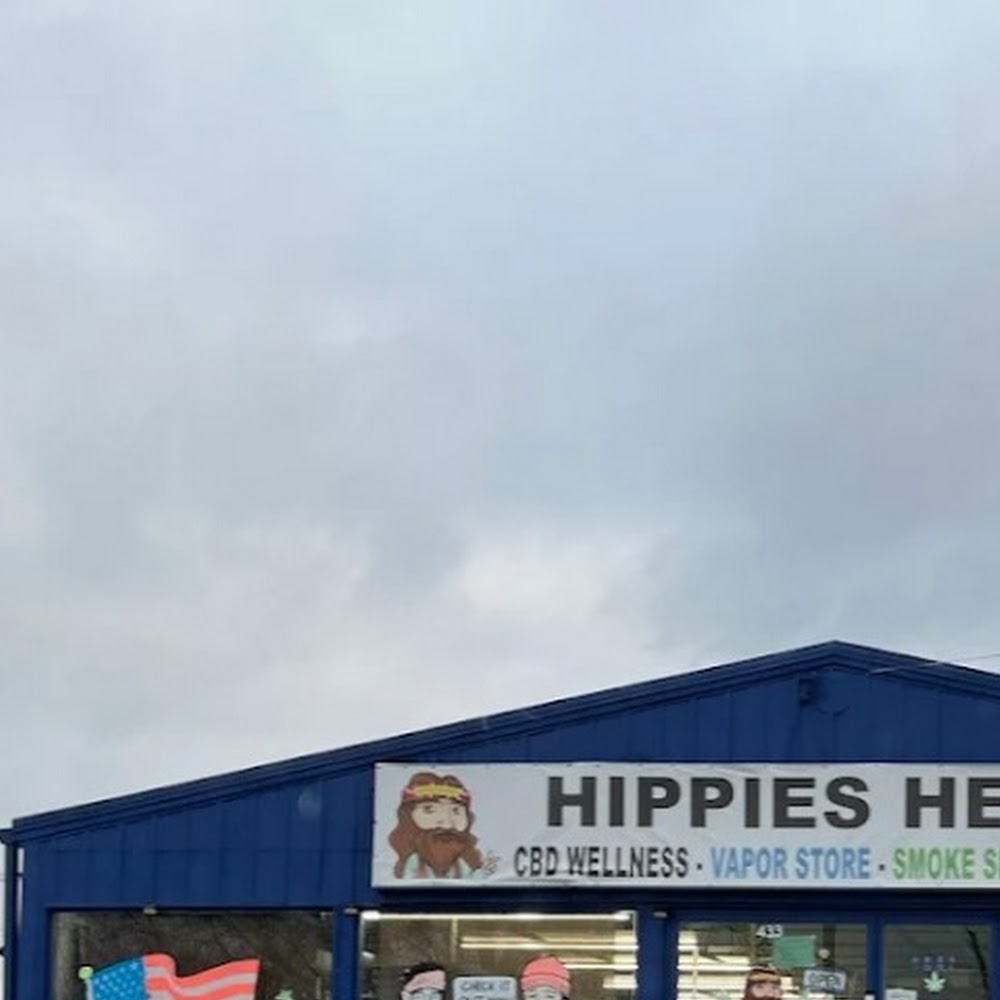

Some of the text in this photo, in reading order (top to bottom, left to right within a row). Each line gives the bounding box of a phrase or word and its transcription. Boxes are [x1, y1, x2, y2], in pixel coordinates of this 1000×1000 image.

[546, 775, 870, 829] HIPPIES
[513, 845, 560, 877] CBD
[567, 845, 690, 879] WELLNESS
[710, 847, 788, 880] VAPOR
[795, 847, 871, 880] STORE
[892, 847, 975, 880] SMOKE
